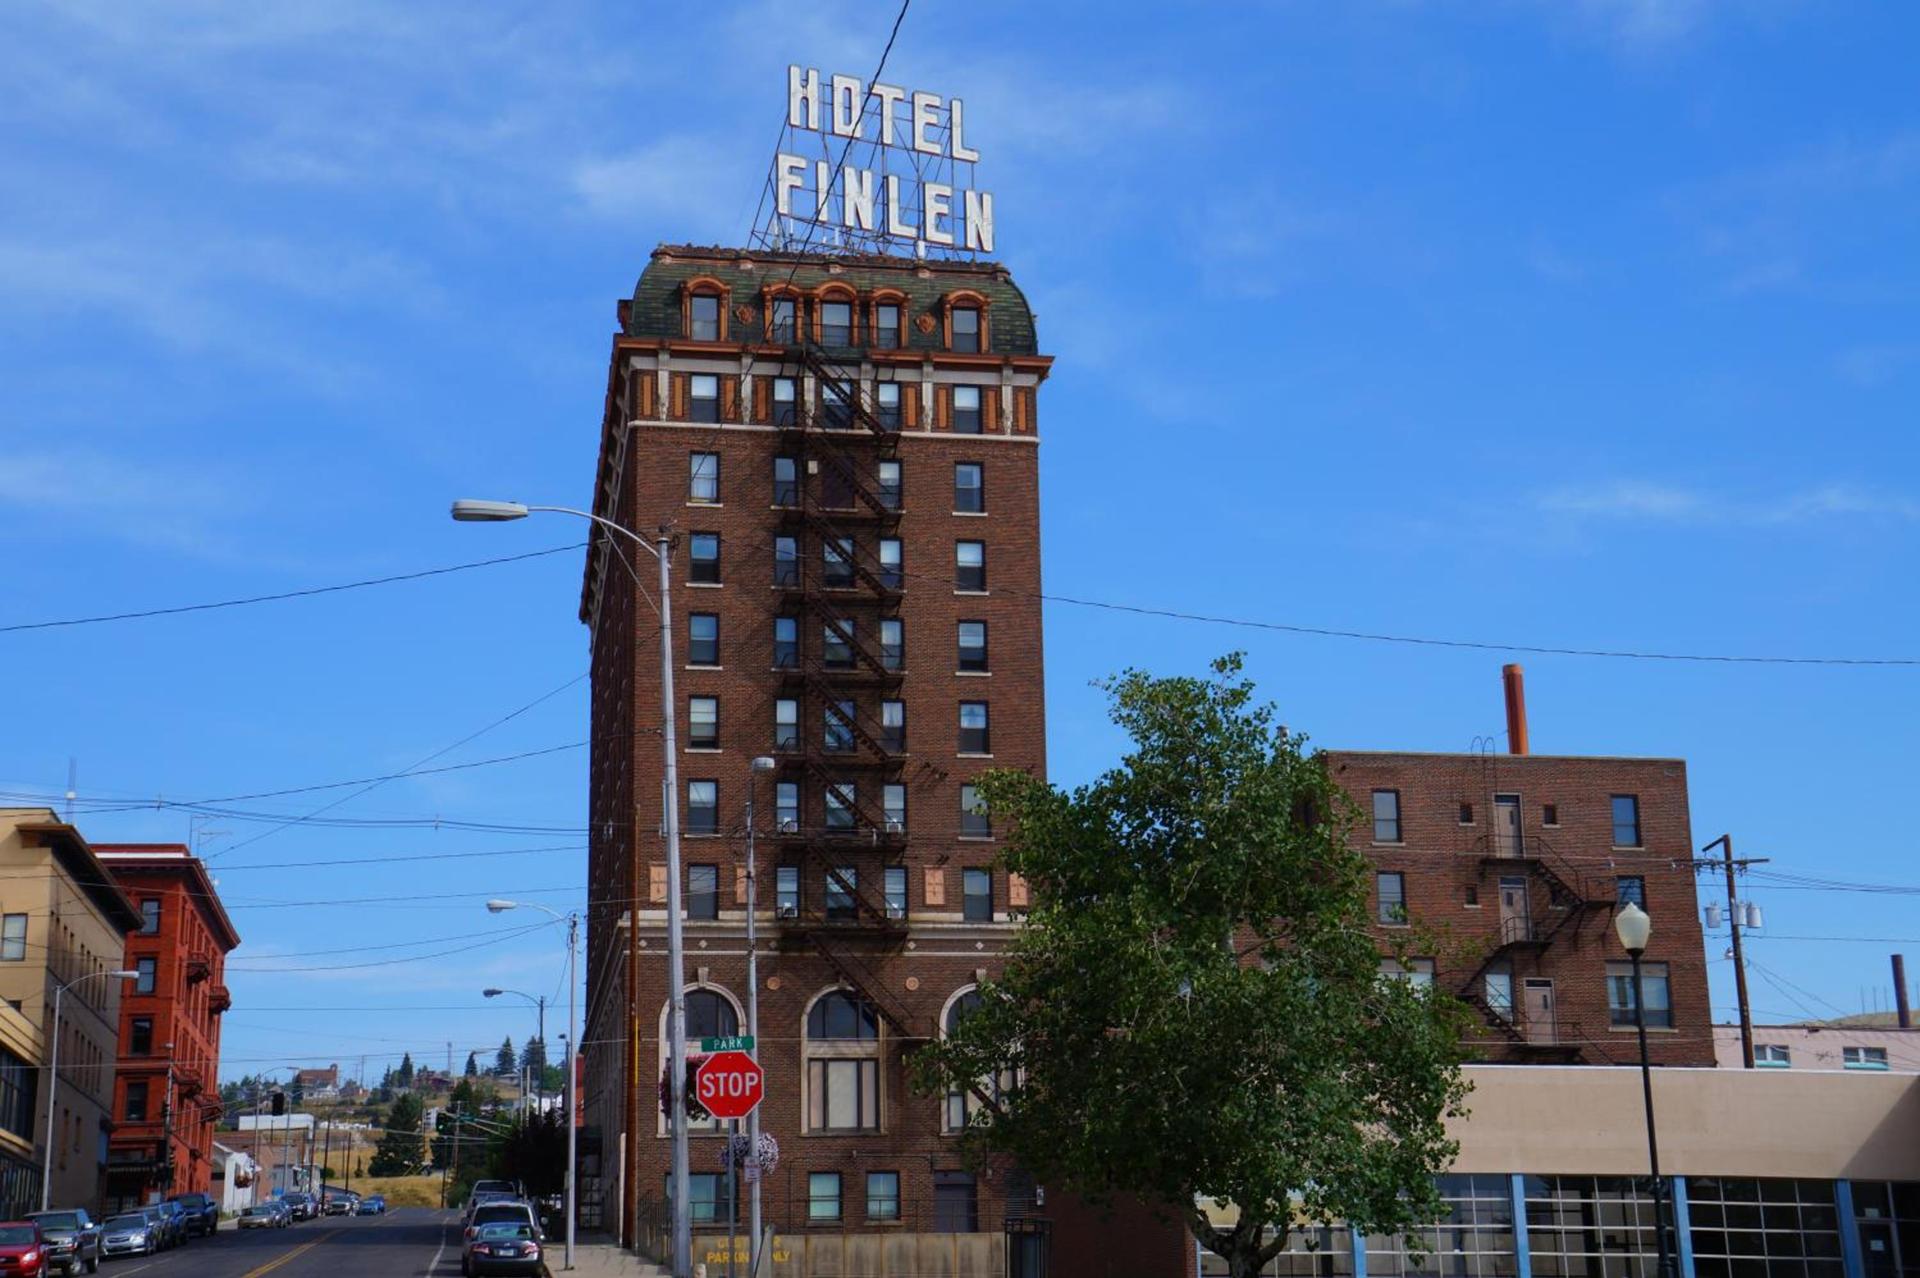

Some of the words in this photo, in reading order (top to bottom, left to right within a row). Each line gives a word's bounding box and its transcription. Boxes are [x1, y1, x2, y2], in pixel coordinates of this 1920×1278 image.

[788, 64, 979, 163] HOTEL
[776, 152, 993, 252] FINLEN
[713, 1037, 743, 1050] PARK
[702, 1071, 759, 1098] STOP
